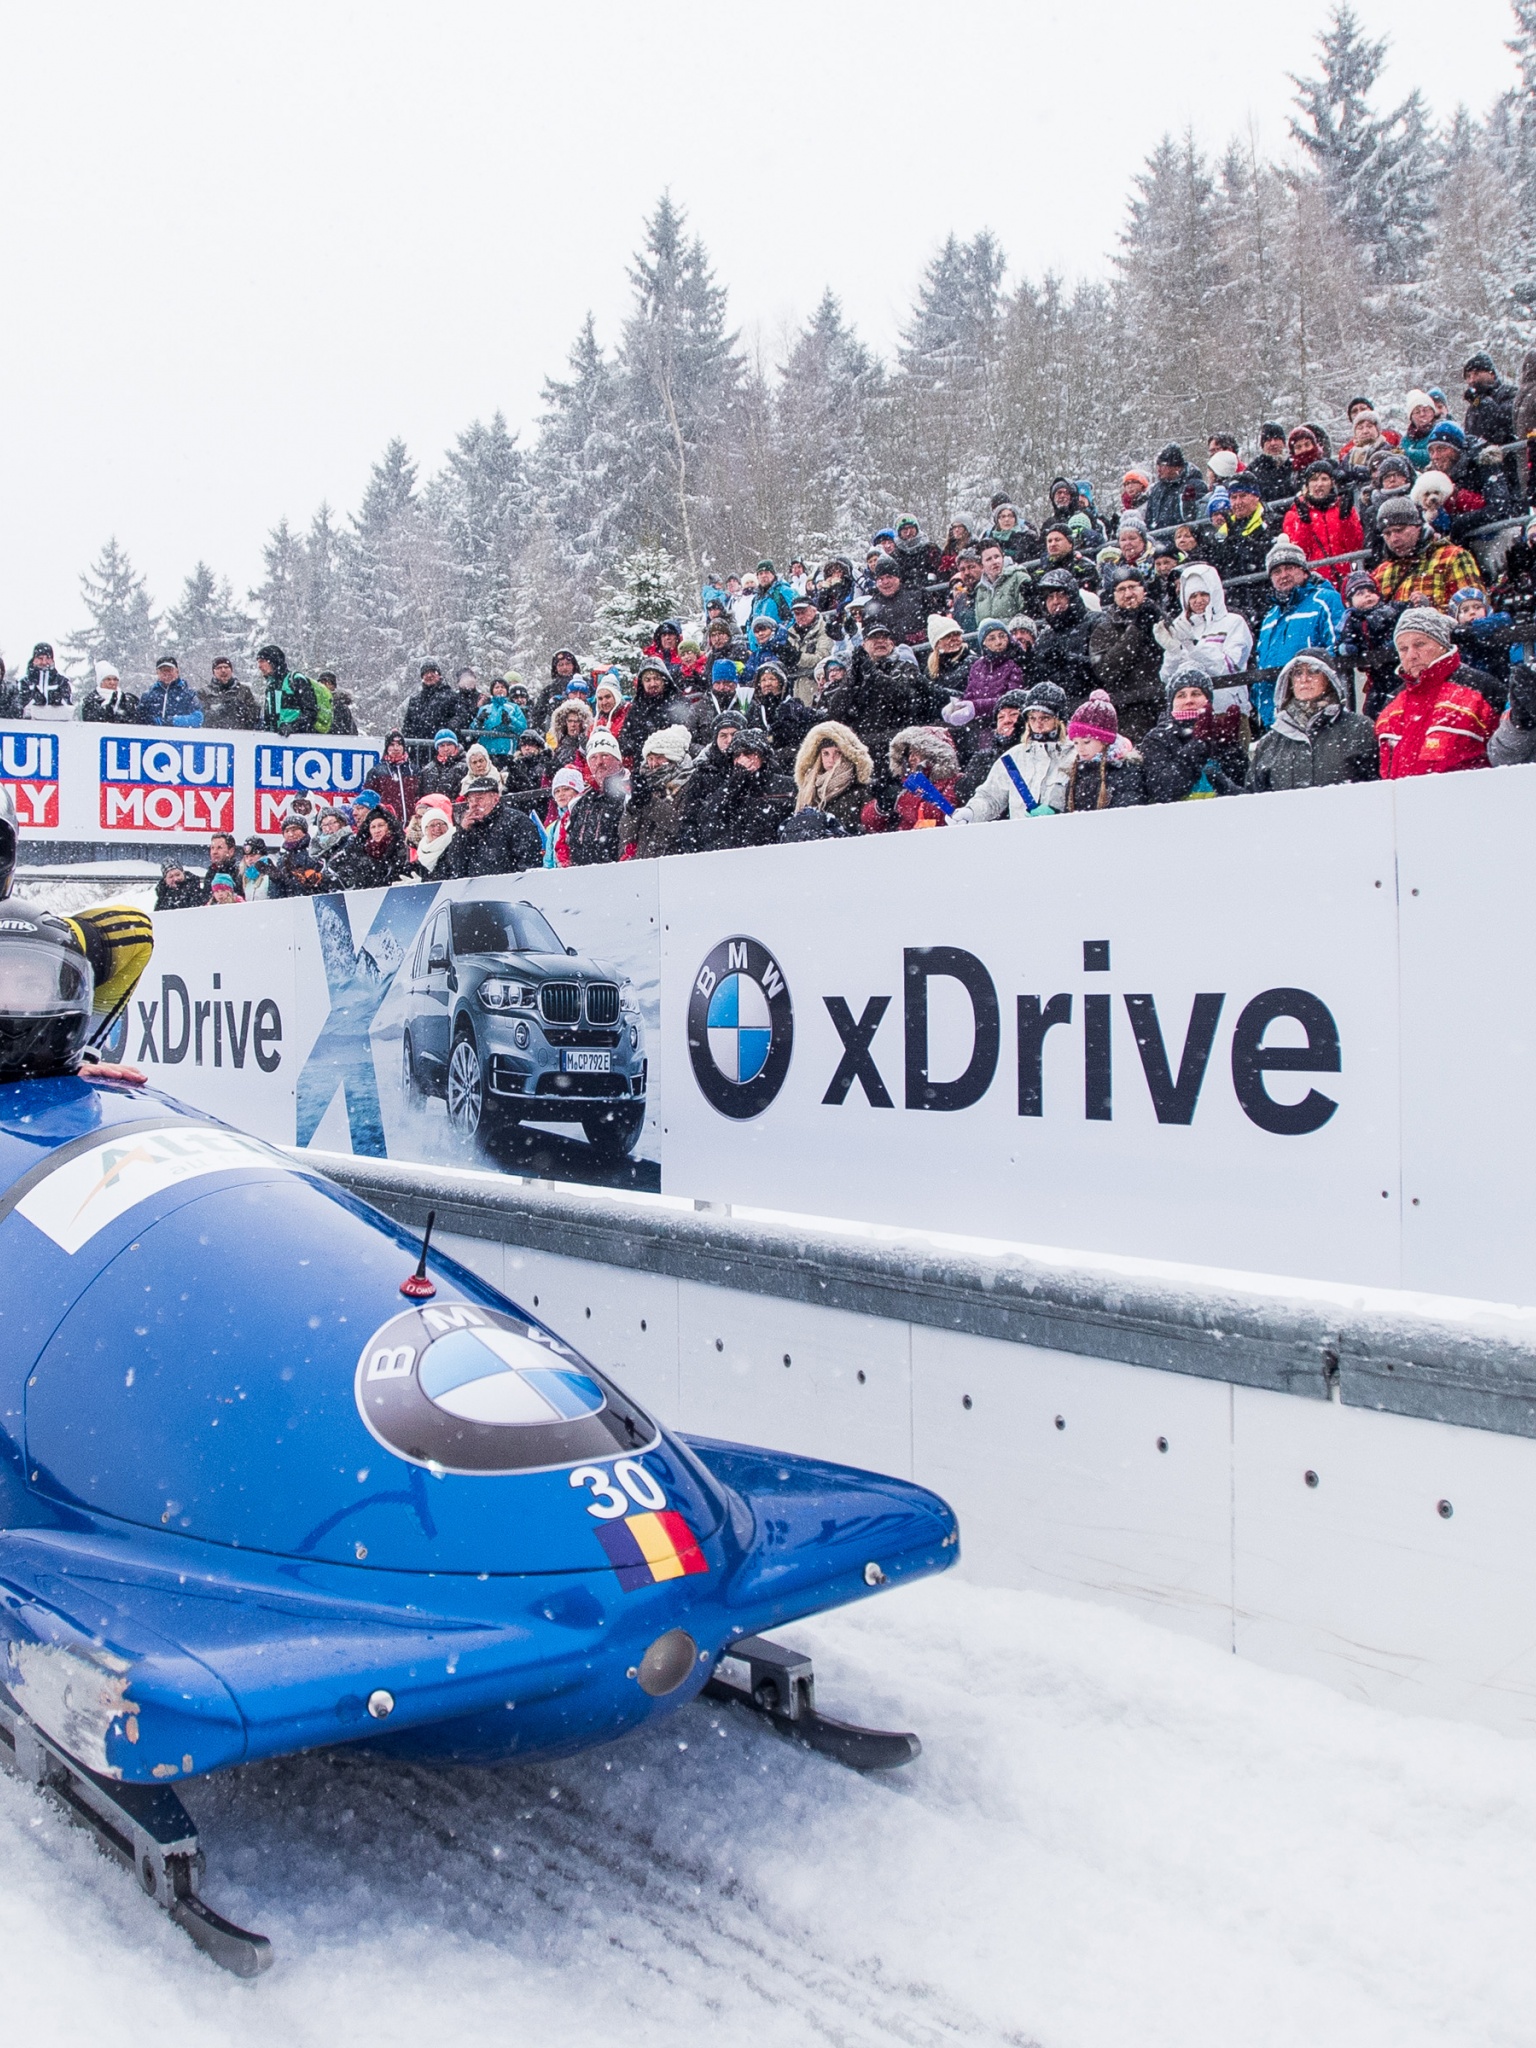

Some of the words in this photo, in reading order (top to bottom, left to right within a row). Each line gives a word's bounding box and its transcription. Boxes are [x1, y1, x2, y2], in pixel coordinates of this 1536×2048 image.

[0, 736, 52, 777] UI
[106, 741, 229, 785] LIQUI
[261, 749, 374, 790] LIQUI
[3, 783, 57, 823] LY
[106, 787, 232, 828] MOLY
[697, 942, 784, 999] BMW
[137, 973, 282, 1073] xDrive
[821, 940, 1342, 1135] xDrive
[367, 1306, 578, 1382] BMW
[568, 1459, 667, 1520] 30
